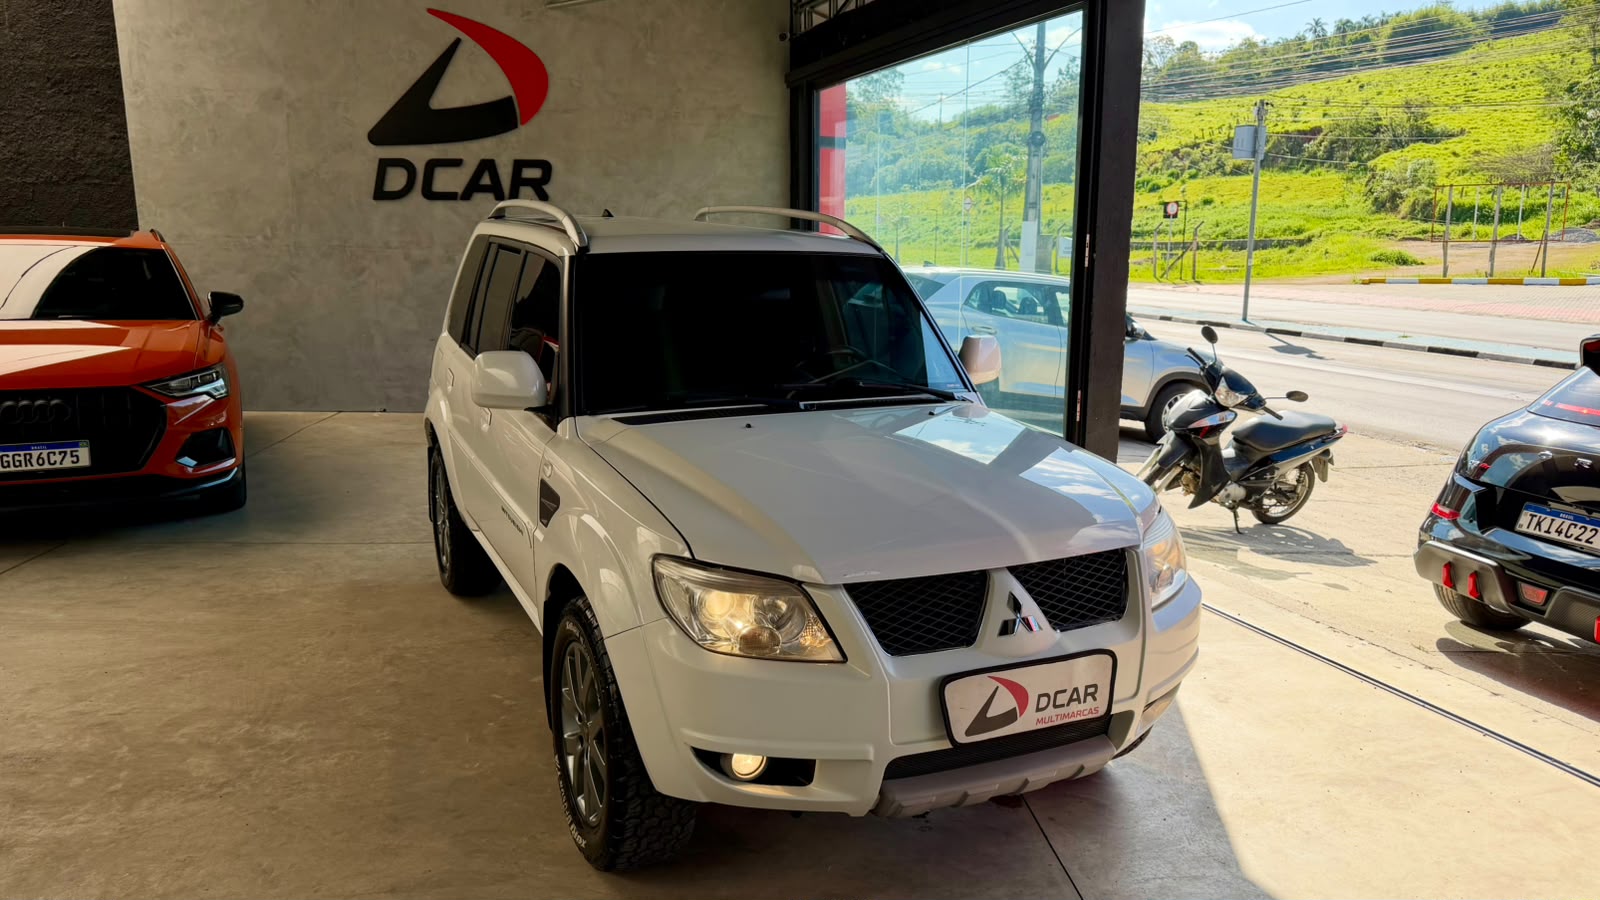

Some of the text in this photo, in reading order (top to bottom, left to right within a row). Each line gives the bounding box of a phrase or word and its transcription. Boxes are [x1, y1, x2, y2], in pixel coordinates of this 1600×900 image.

[372, 157, 553, 201] DCAR
[0, 449, 80, 469] GGR6C75
[1526, 513, 1599, 545] TKI4C22
[1035, 683, 1099, 713] DCAR
[1035, 706, 1100, 726] MULTIMARCAS
